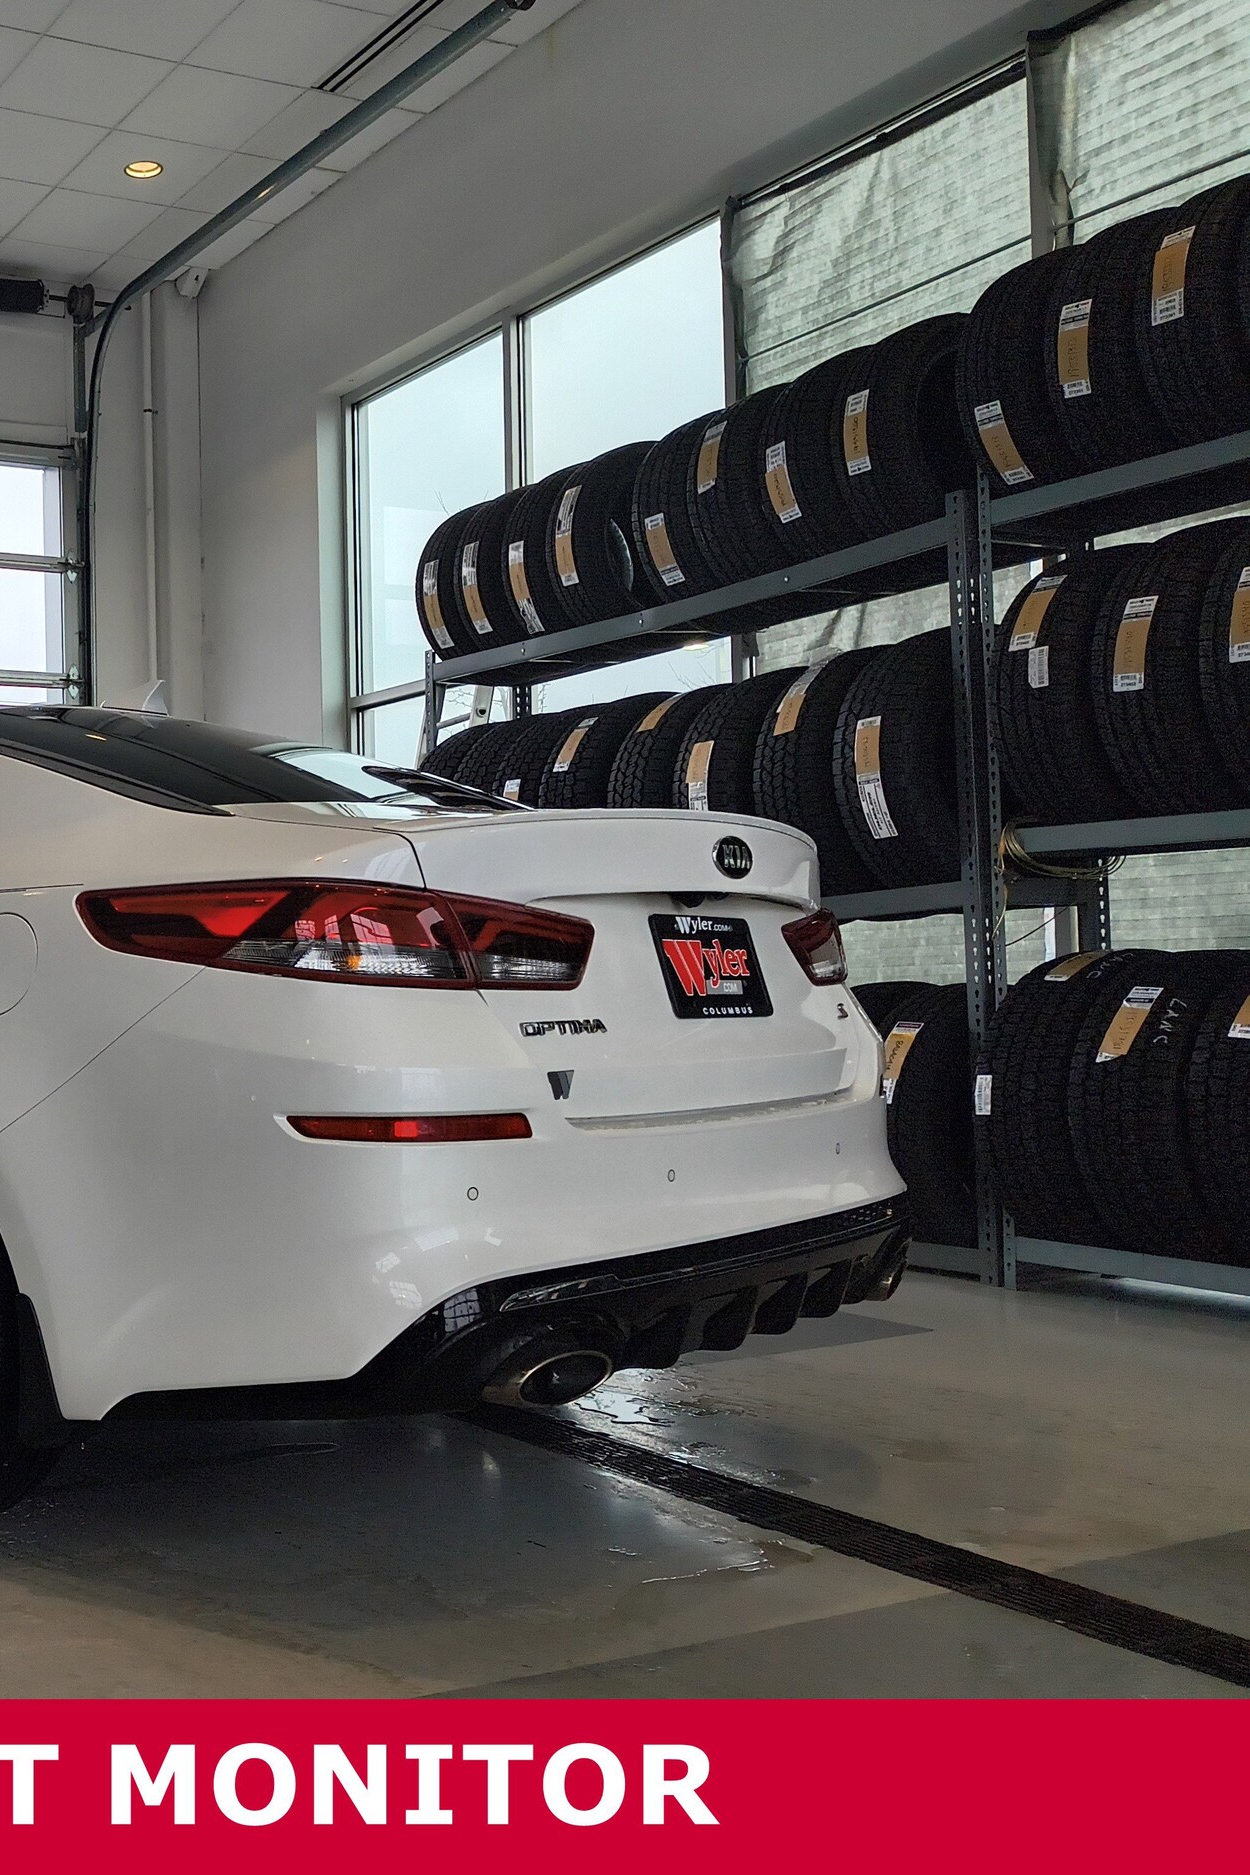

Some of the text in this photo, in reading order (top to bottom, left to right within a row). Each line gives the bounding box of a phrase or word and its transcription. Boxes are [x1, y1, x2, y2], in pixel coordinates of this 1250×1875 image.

[723, 844, 751, 869] KIA
[662, 939, 750, 996] Wyler
[702, 1005, 753, 1015] COLUMBUS
[519, 1019, 608, 1037] OPTIMA
